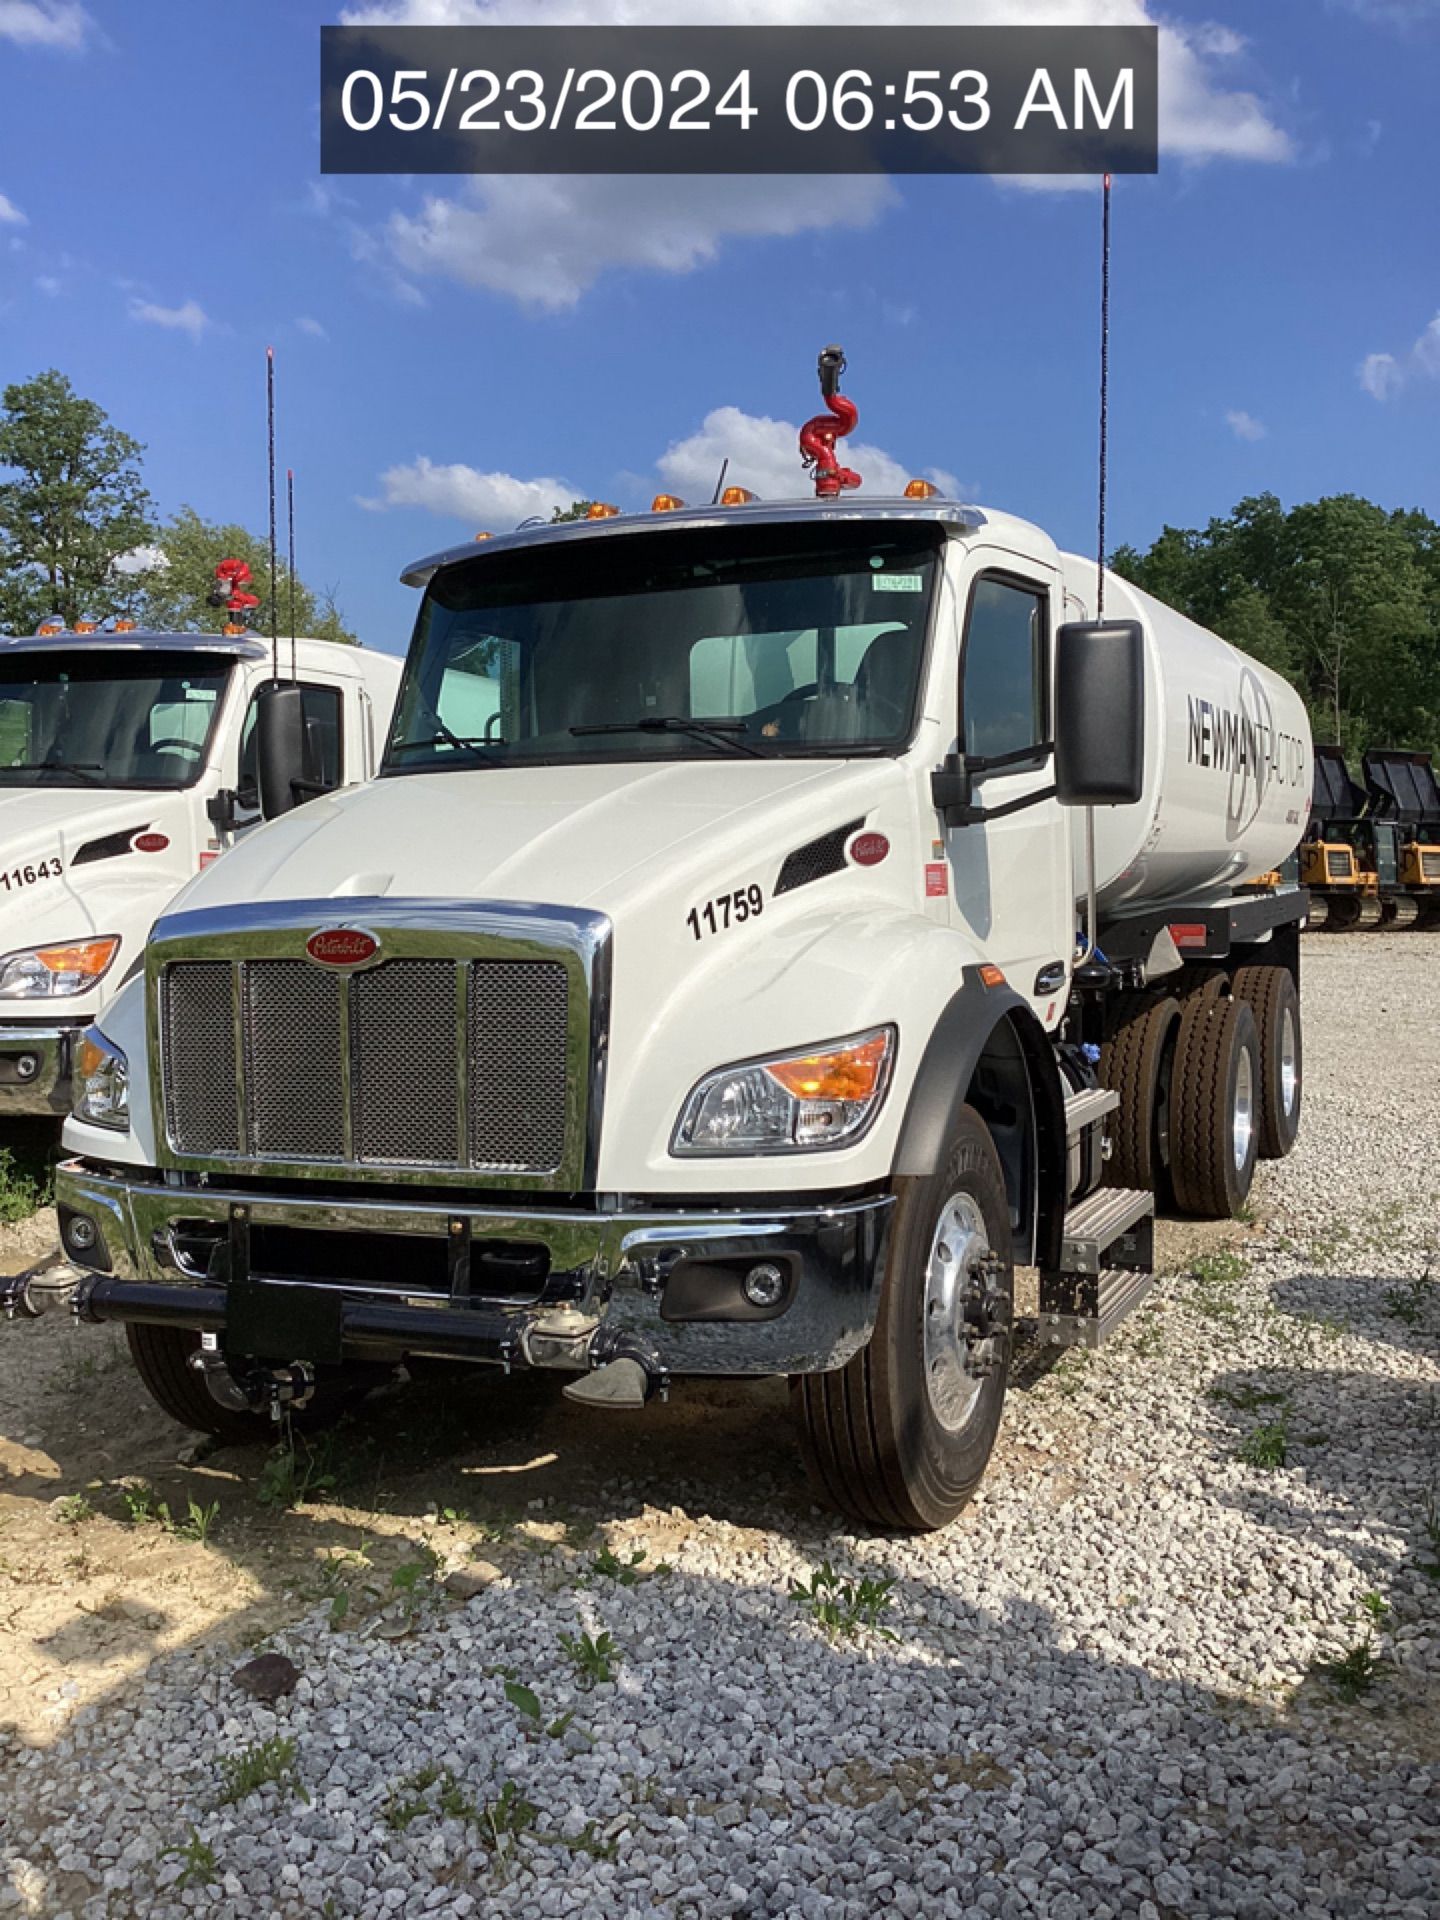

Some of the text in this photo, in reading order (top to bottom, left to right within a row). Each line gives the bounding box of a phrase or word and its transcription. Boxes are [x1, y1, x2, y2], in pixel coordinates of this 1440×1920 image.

[1187, 693, 1257, 780] NEWMAN
[0, 857, 63, 891] 11643
[686, 883, 763, 941] 11759
